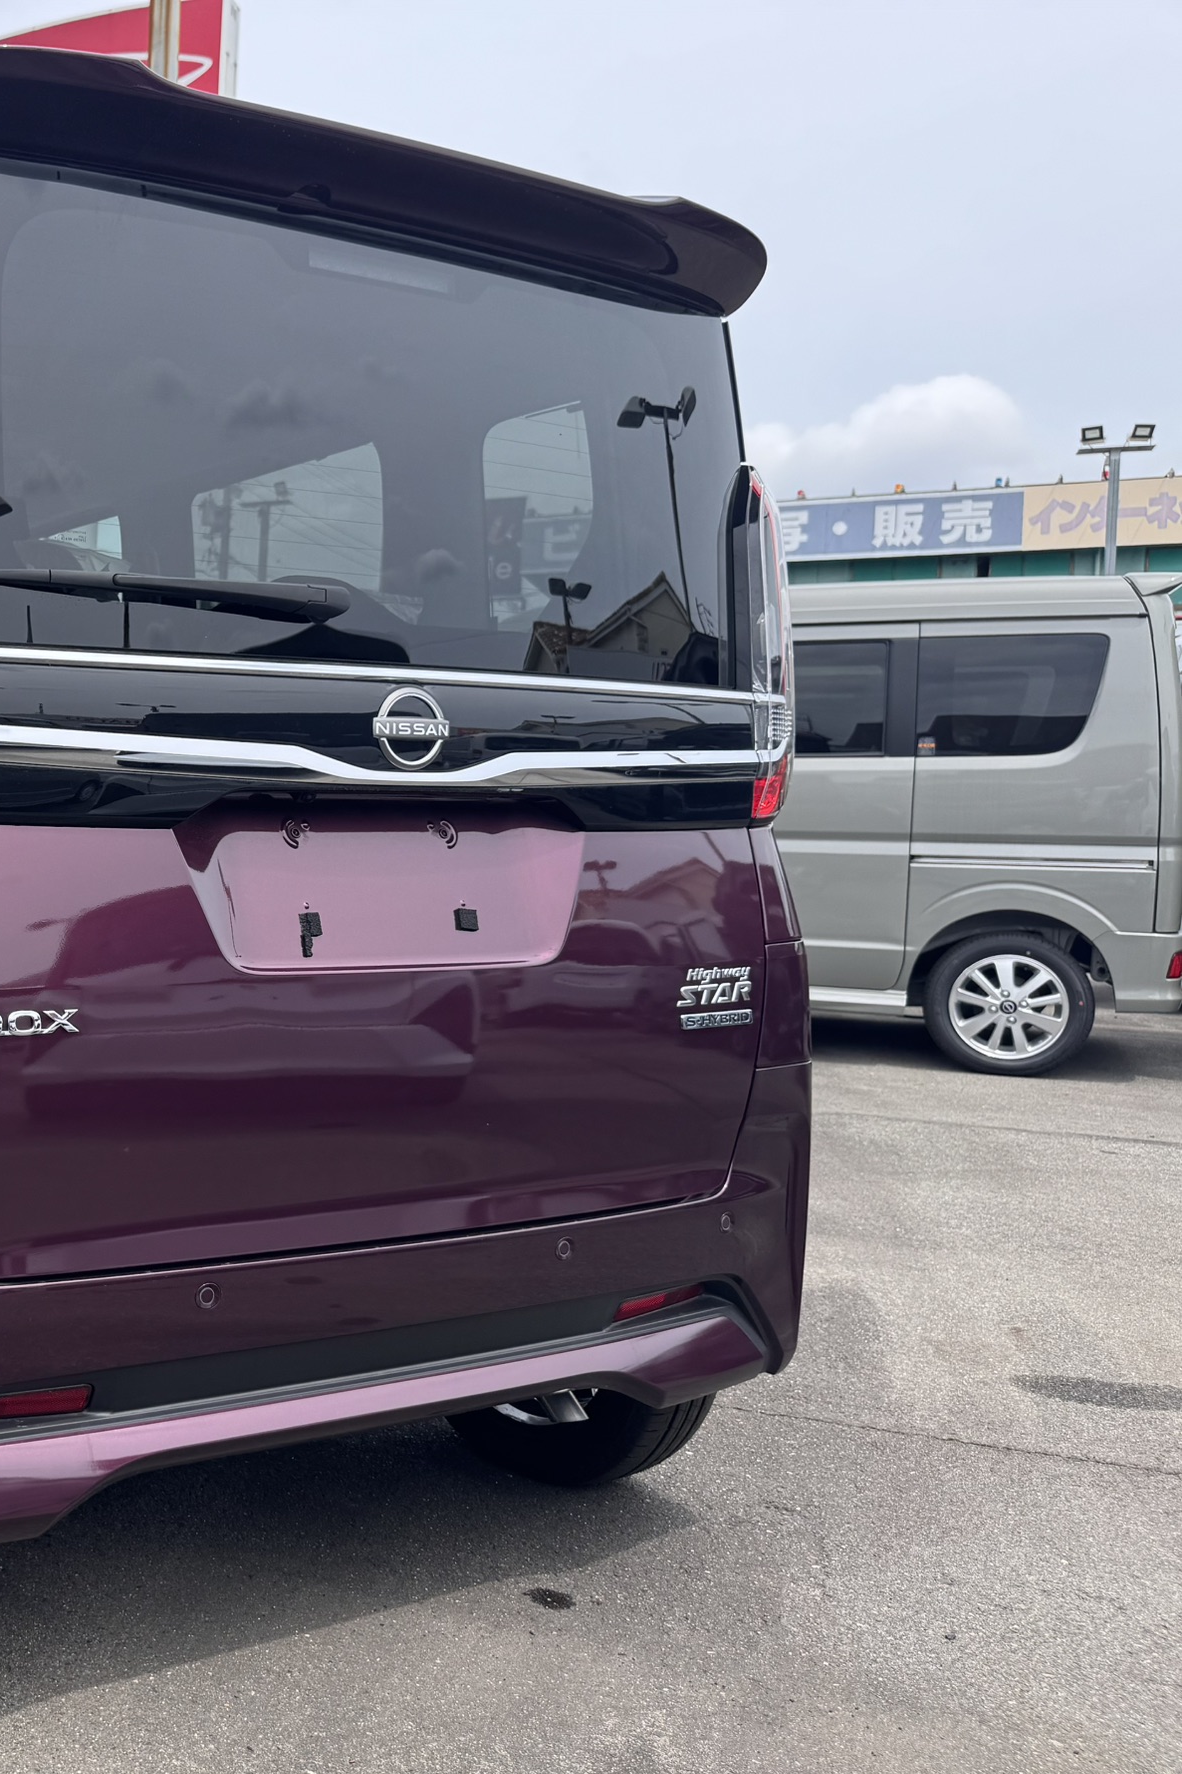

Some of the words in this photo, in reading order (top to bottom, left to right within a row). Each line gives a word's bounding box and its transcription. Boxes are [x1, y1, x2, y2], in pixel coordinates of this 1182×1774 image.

[1028, 491, 1182, 535] インターネ
[375, 722, 449, 737] NISSAN
[686, 966, 751, 984] Highway
[676, 980, 752, 1008] STAR
